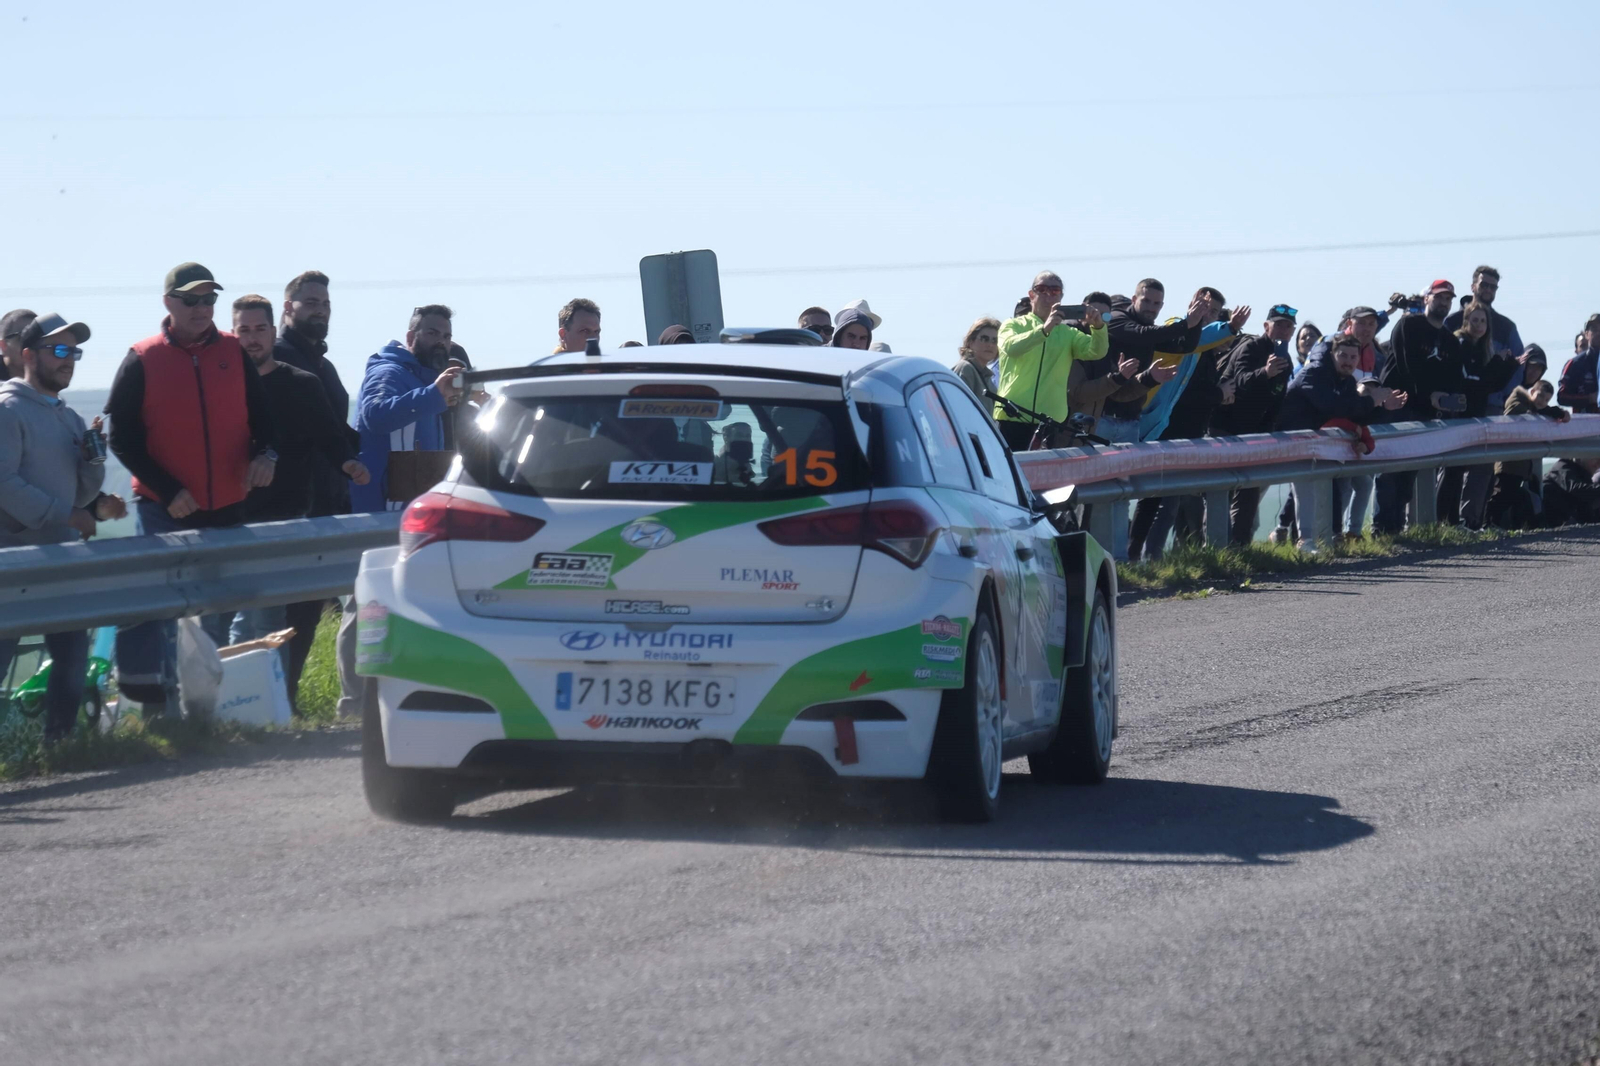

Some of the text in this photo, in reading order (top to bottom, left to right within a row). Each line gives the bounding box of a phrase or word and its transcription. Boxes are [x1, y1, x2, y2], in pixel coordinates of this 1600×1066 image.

[622, 462, 699, 476] KTVA
[773, 447, 838, 488] 15
[720, 567, 795, 583] PLEMAR
[761, 582, 800, 591] SPORT
[613, 632, 734, 648] HYUNDAI
[643, 650, 701, 661] Reinauto
[577, 678, 721, 708] 7138 KFG
